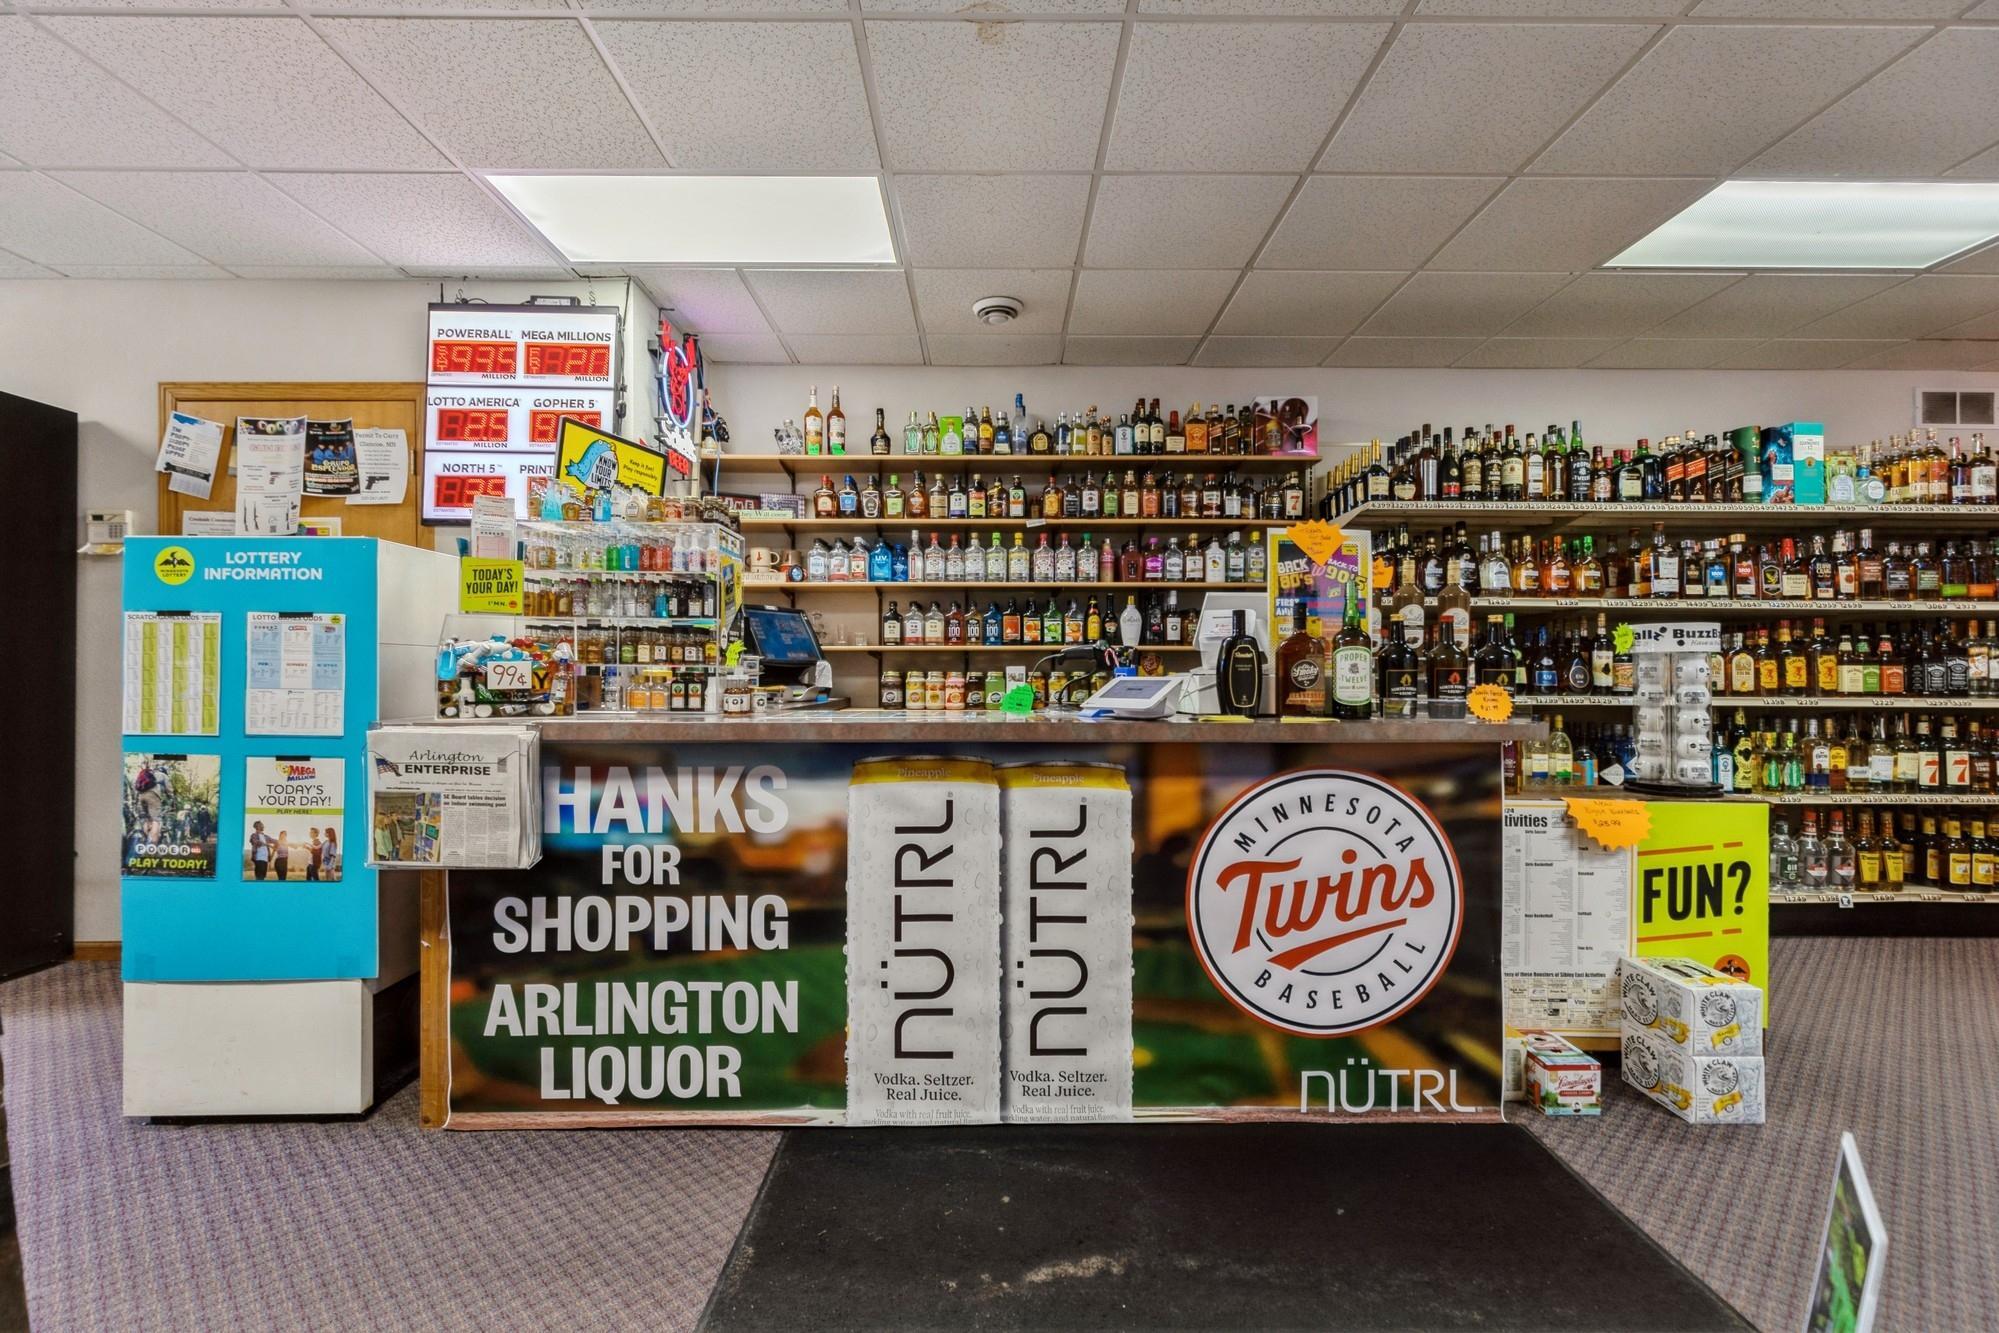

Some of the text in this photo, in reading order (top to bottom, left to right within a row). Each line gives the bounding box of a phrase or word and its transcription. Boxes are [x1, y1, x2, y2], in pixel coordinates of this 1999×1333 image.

[437, 329, 510, 339] POWERBALL
[521, 330, 612, 342] MEGA MILLIONS
[427, 397, 520, 408] LOTTO AMERICA
[533, 399, 595, 408] GOPHER 5
[442, 463, 496, 473] NORTH 5
[599, 455, 616, 471] KNOW
[595, 464, 611, 478] YOUR
[591, 473, 612, 488] LIMITS
[1290, 495, 1301, 510] 7
[226, 551, 302, 565] LOTTERY
[1277, 557, 1309, 575] BACK
[204, 567, 323, 580] INFORMATION
[472, 569, 513, 581] TODAY'S
[466, 581, 518, 595] YOUR DAY!
[949, 626, 961, 637] 100
[968, 626, 979, 637] 100
[986, 626, 999, 637] 100
[409, 749, 484, 765] Arlington
[289, 764, 316, 776] MEGA
[404, 764, 491, 776] ENTERPRISE
[897, 766, 952, 779] Pineapple
[1922, 759, 1939, 785] 7
[1953, 758, 1969, 785] 7
[1032, 773, 1085, 784] Pineapple
[266, 784, 324, 795] TODAY'S
[258, 795, 332, 807] YOUR DAY!
[544, 765, 789, 834] HANKS
[1233, 793, 1416, 853] MINNESOTA
[1504, 814, 1548, 828] tivities
[128, 858, 208, 870] PLAY TODAY!
[602, 845, 681, 885] FOR
[1642, 860, 1752, 924] FUN?
[1215, 848, 1435, 954] Twins
[493, 895, 789, 953] SHOPPING
[1254, 941, 1426, 1010] BASEBALL
[1623, 973, 1656, 999] WHITE CLAW
[483, 981, 799, 1037] ARLINGTON
[1700, 991, 1731, 1018] WHITE CLAW
[1624, 1035, 1657, 1061] WHITE CLAW
[540, 1045, 742, 1104] LIQUOR
[1010, 1070, 1108, 1084] Vodka. Seltzer.
[1701, 1058, 1733, 1086] WHITE CLAW
[874, 1072, 974, 1087] Vodka. Seltzer.
[1300, 1057, 1476, 1114] NÜTRL
[886, 1088, 962, 1102] Real Juice.
[1022, 1084, 1096, 1098] Real Juice.
[875, 1108, 897, 1119] Vodka
[898, 1109, 915, 1119] with
[916, 1109, 934, 1120] real
[935, 1109, 951, 1120] fruit
[1012, 1105, 1033, 1115] Vodka
[1033, 1105, 1050, 1115] with
[1050, 1105, 1069, 1115] real
[1070, 1105, 1086, 1115] fruit
